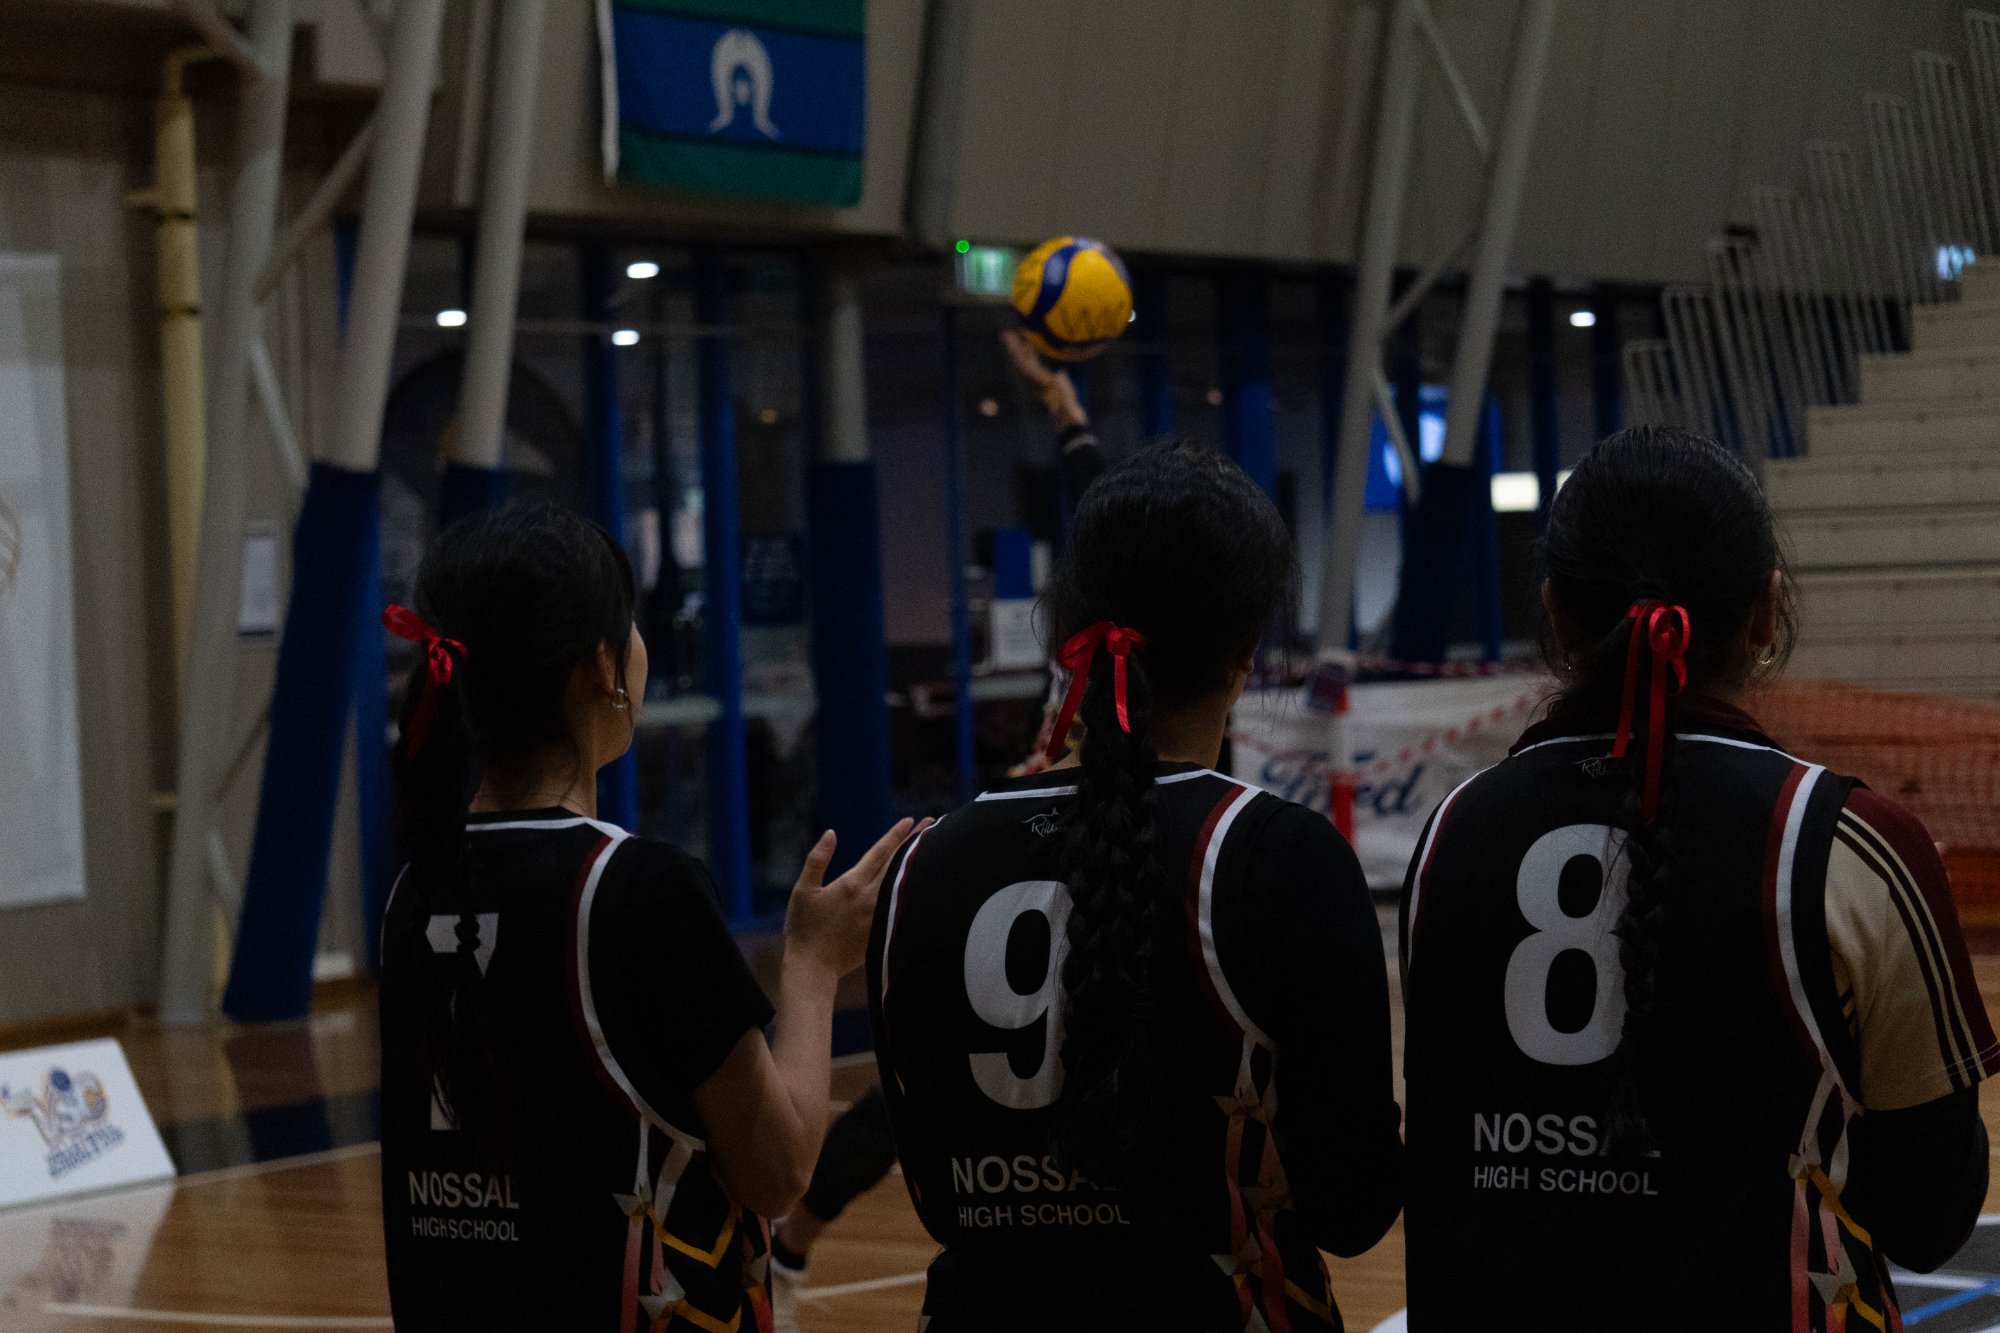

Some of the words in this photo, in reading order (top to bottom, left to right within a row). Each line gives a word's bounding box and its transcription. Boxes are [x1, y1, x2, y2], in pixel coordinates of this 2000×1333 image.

[1503, 823, 1633, 1067] 8
[963, 880, 1075, 1111] 9
[1473, 1112, 1662, 1158] NOSS
[408, 1171, 520, 1210] NOSSAL
[951, 1154, 1120, 1194] NOSSA
[1473, 1165, 1530, 1191] HIGH
[1538, 1167, 1660, 1196] SCHOOL
[958, 1204, 1015, 1228] HIGH
[1019, 1201, 1132, 1228] SCHOOL
